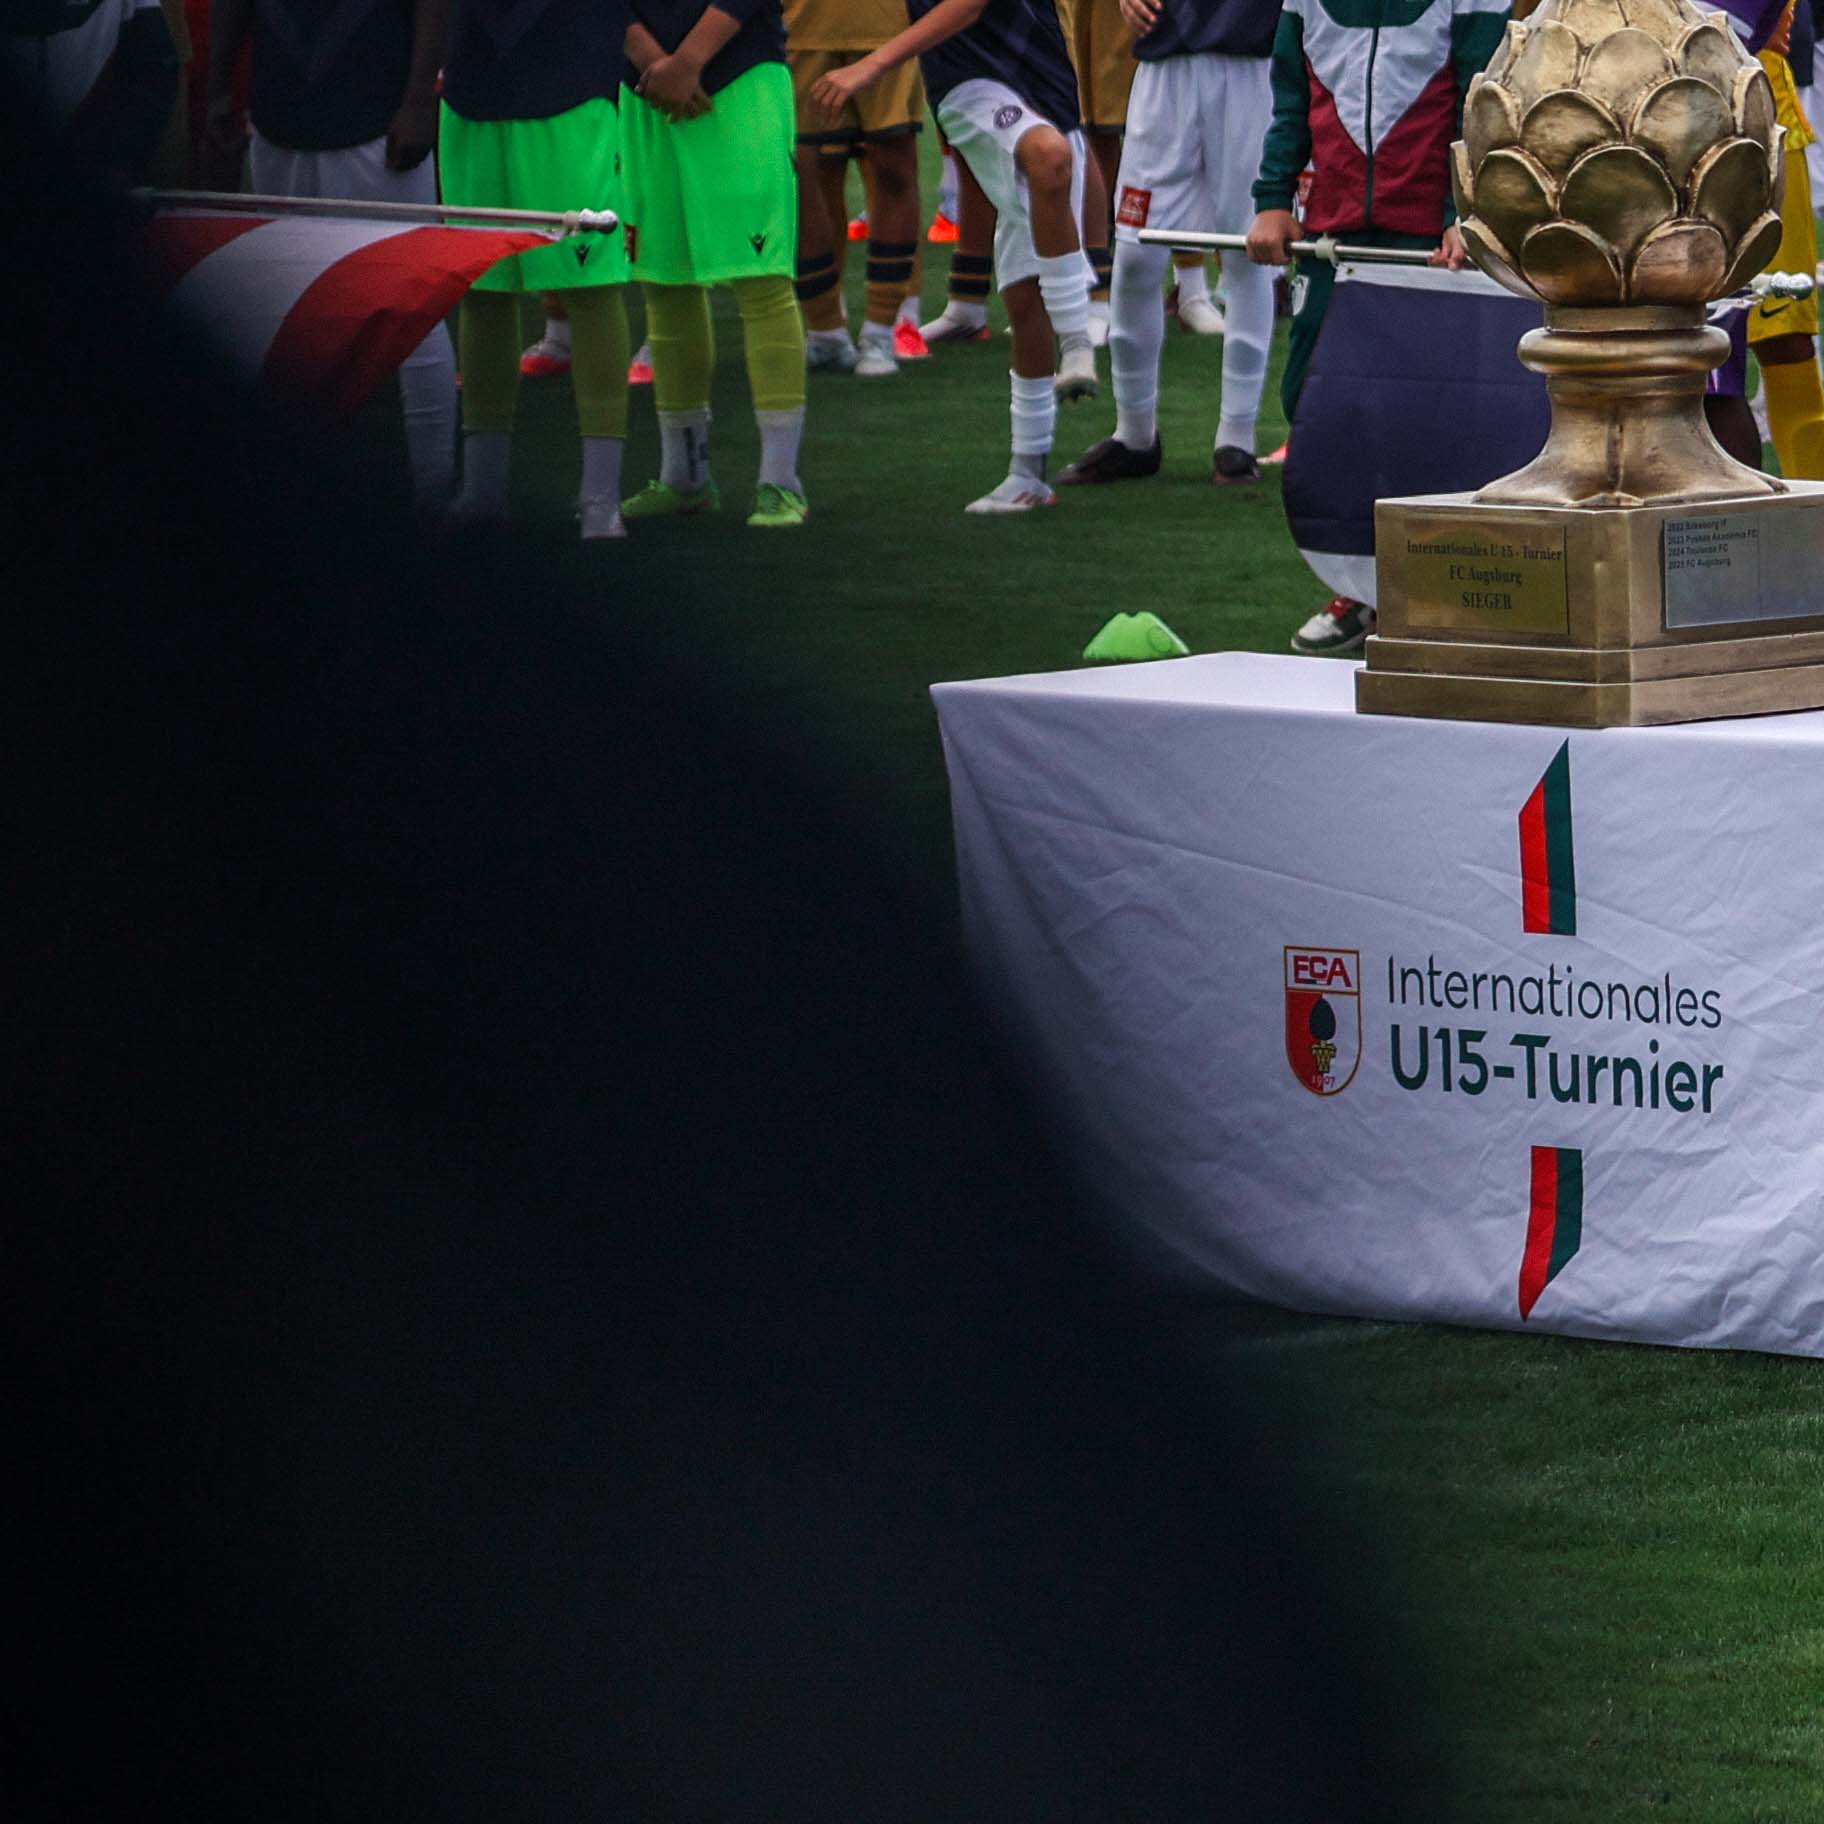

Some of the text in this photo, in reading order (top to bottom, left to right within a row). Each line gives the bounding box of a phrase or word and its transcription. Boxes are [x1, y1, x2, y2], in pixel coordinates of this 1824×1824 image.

[1450, 564, 1523, 587] FC Augsburg
[1462, 591, 1513, 610] SIEGER
[1388, 954, 1722, 1028] Internationales
[1390, 1023, 1724, 1114] U15-Turnier
